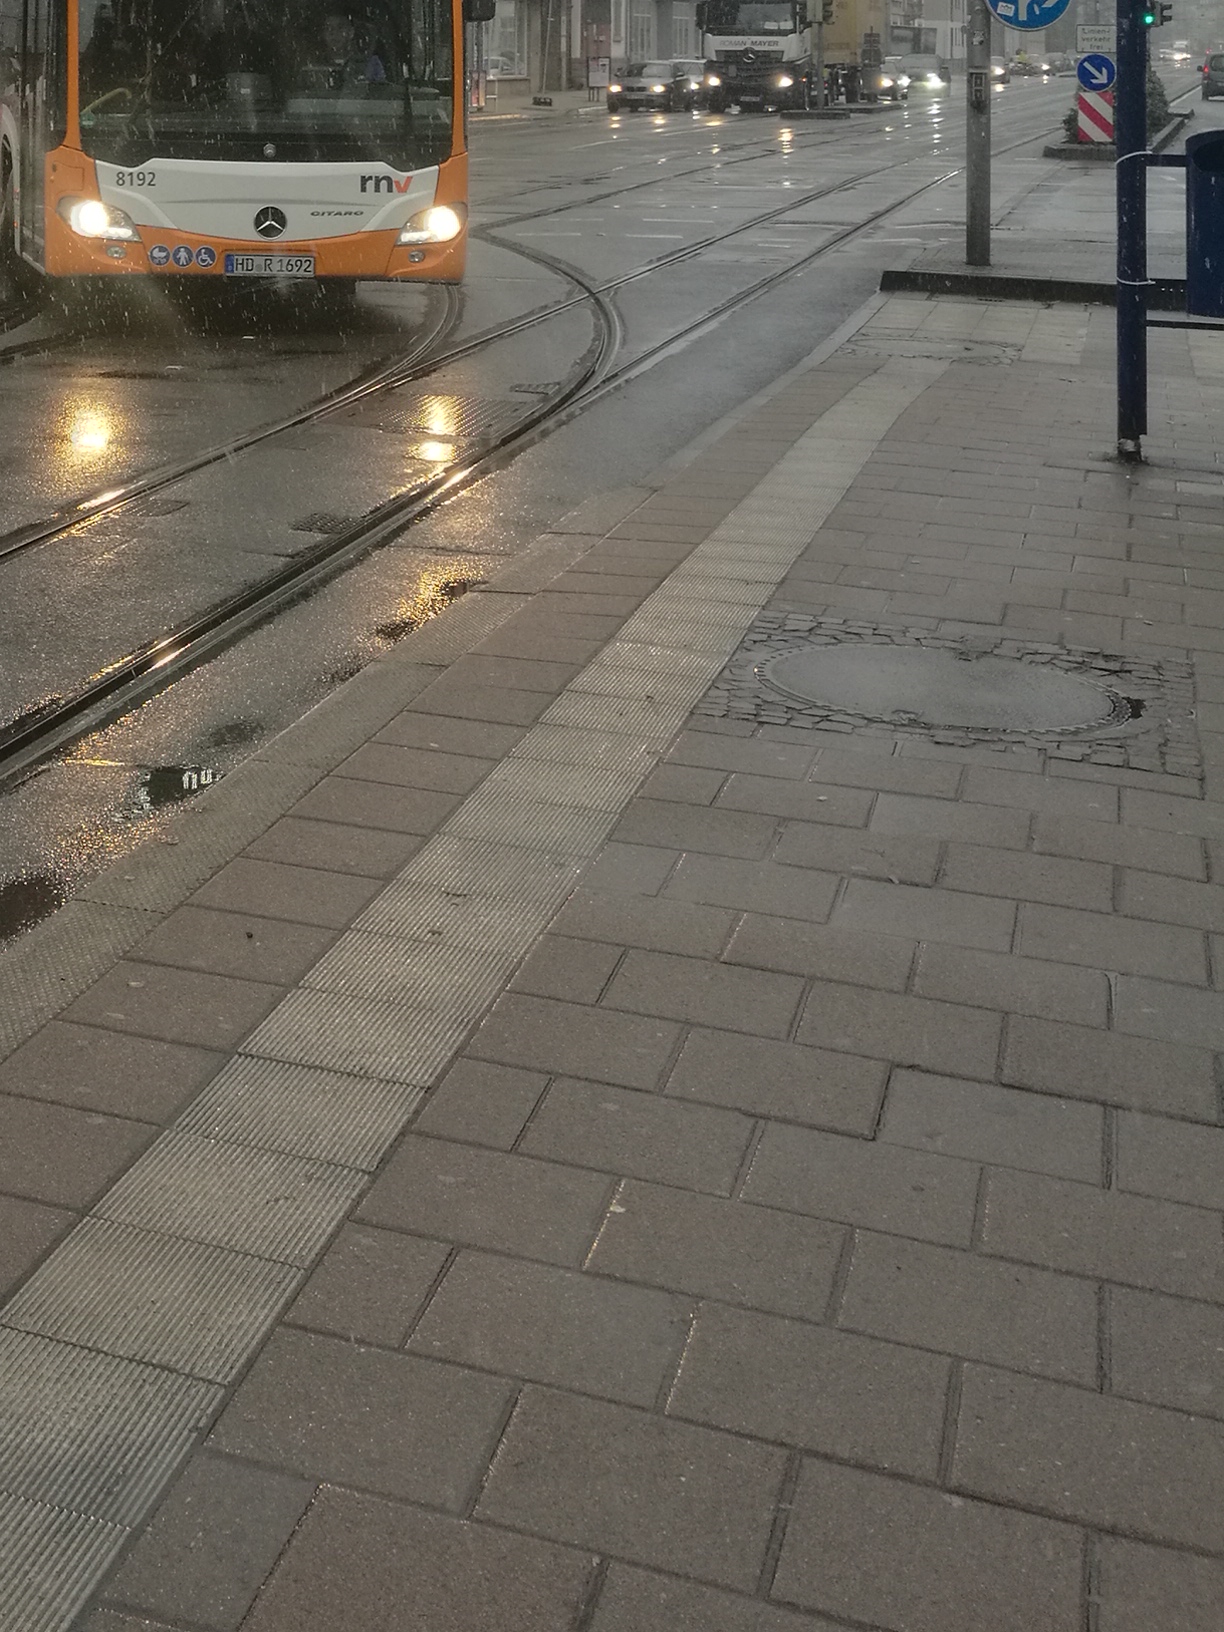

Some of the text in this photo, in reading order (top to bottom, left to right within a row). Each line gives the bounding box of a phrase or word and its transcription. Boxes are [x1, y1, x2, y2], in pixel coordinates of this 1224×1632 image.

[116, 171, 156, 187] 8192
[360, 175, 414, 194] rnv
[235, 258, 312, 273] HD R 1692
